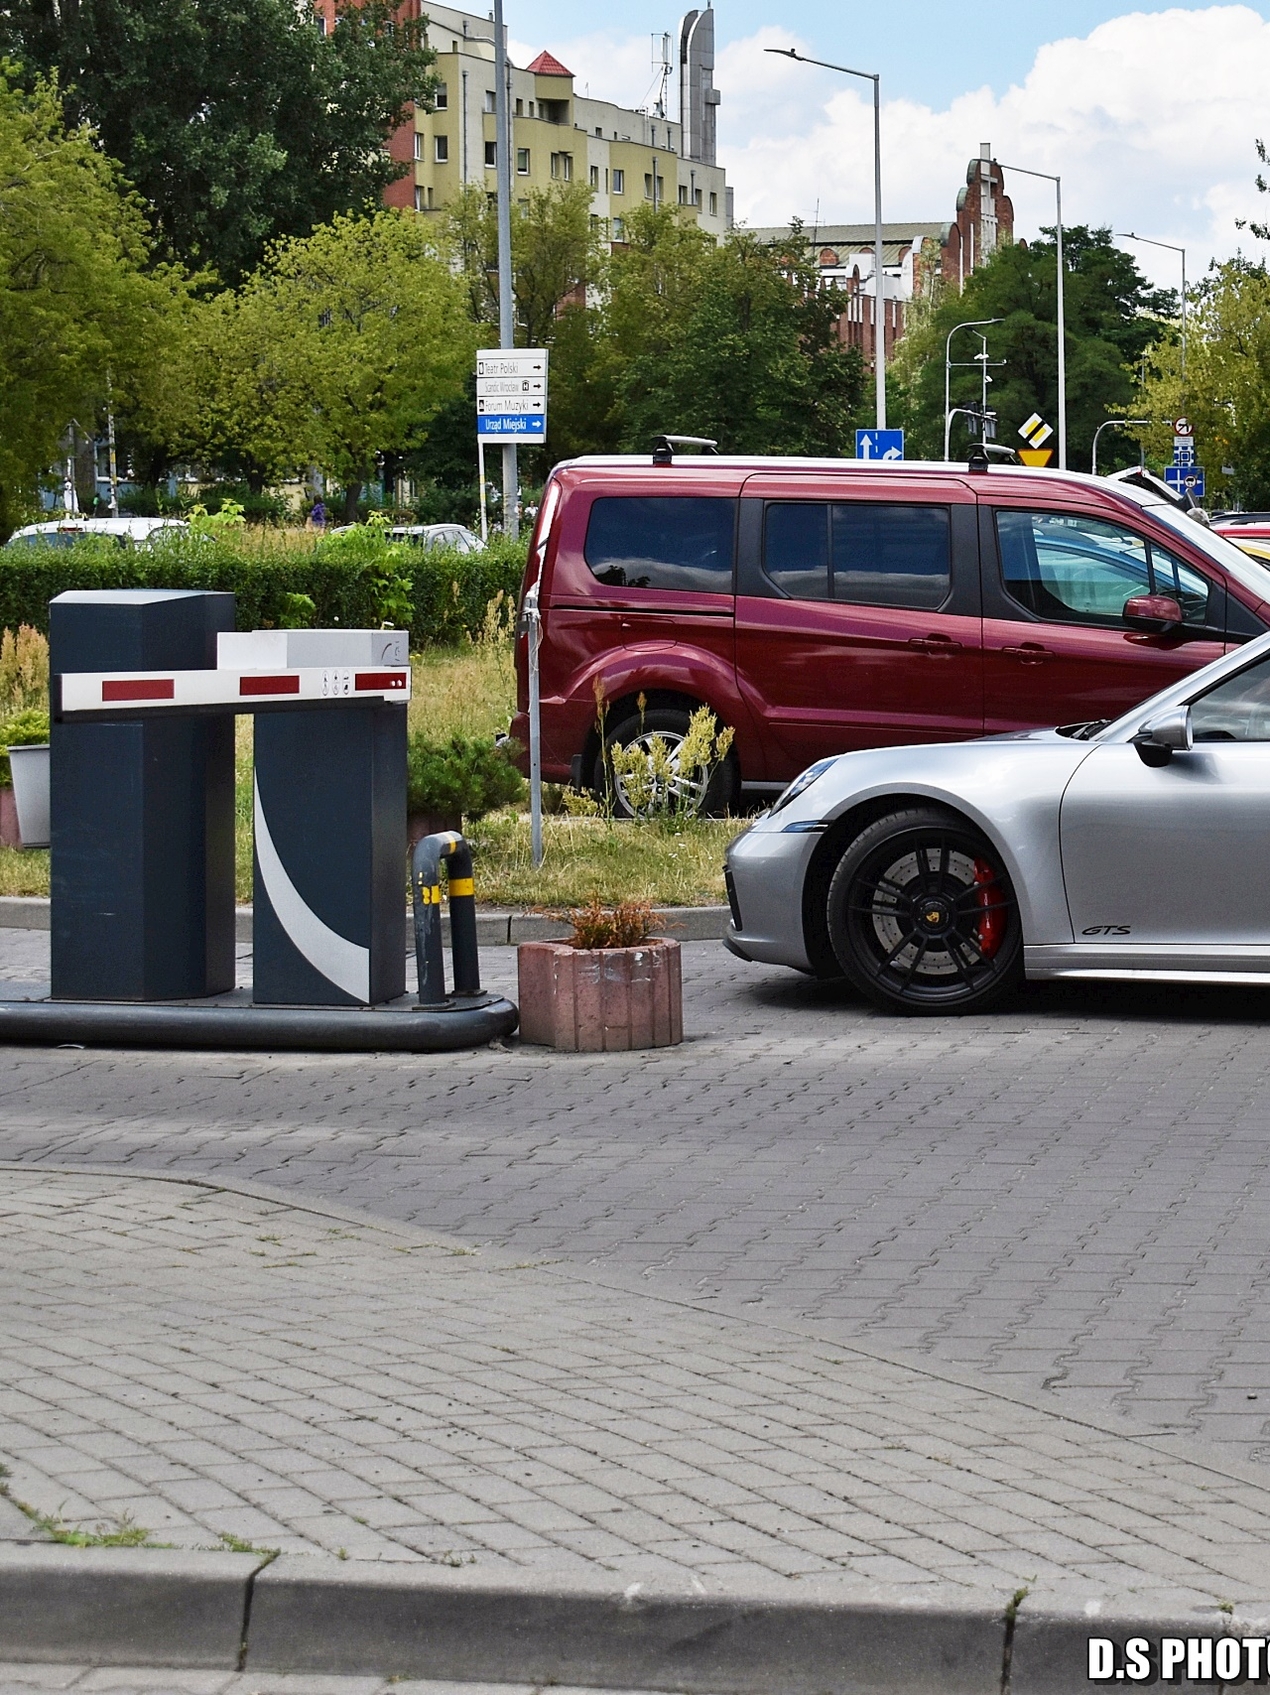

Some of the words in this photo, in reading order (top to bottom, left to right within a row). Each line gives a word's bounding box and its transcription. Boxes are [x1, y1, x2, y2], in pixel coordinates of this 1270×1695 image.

[485, 363, 499, 374] Teatr
[500, 362, 518, 374] Polski
[485, 400, 503, 411] Forum
[504, 399, 529, 413] Muzyki
[485, 418, 501, 432] Urząd
[503, 417, 527, 432] Miejski
[1081, 925, 1131, 935] GTS
